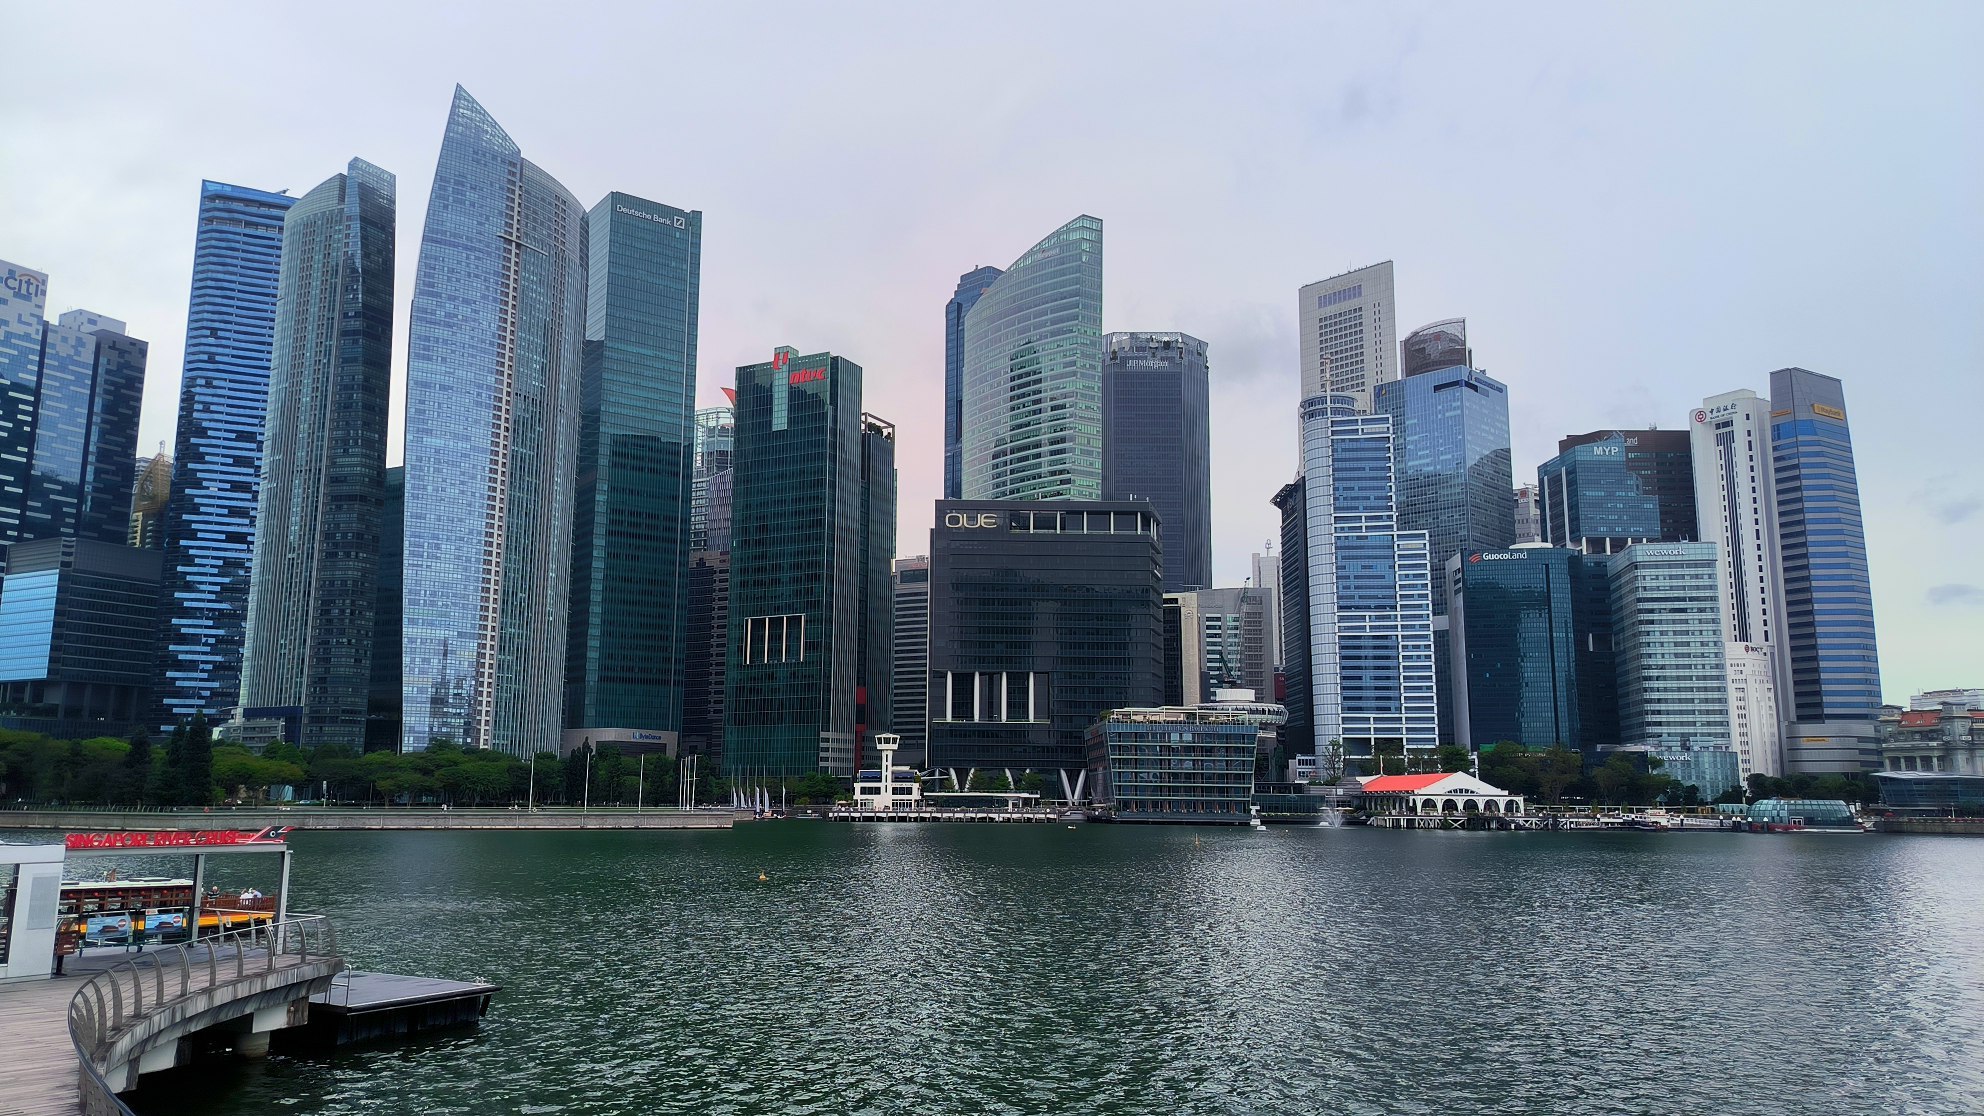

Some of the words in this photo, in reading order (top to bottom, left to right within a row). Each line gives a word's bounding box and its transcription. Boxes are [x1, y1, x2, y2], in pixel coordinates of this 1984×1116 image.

[616, 205, 652, 220] Deutsche
[653, 214, 672, 226] Bank
[1593, 446, 1619, 455] MYP
[1645, 546, 1687, 556] wework
[65, 832, 155, 849] SINGAPORE
[153, 831, 196, 847] RIVER
[195, 830, 239, 846] CRUISE
